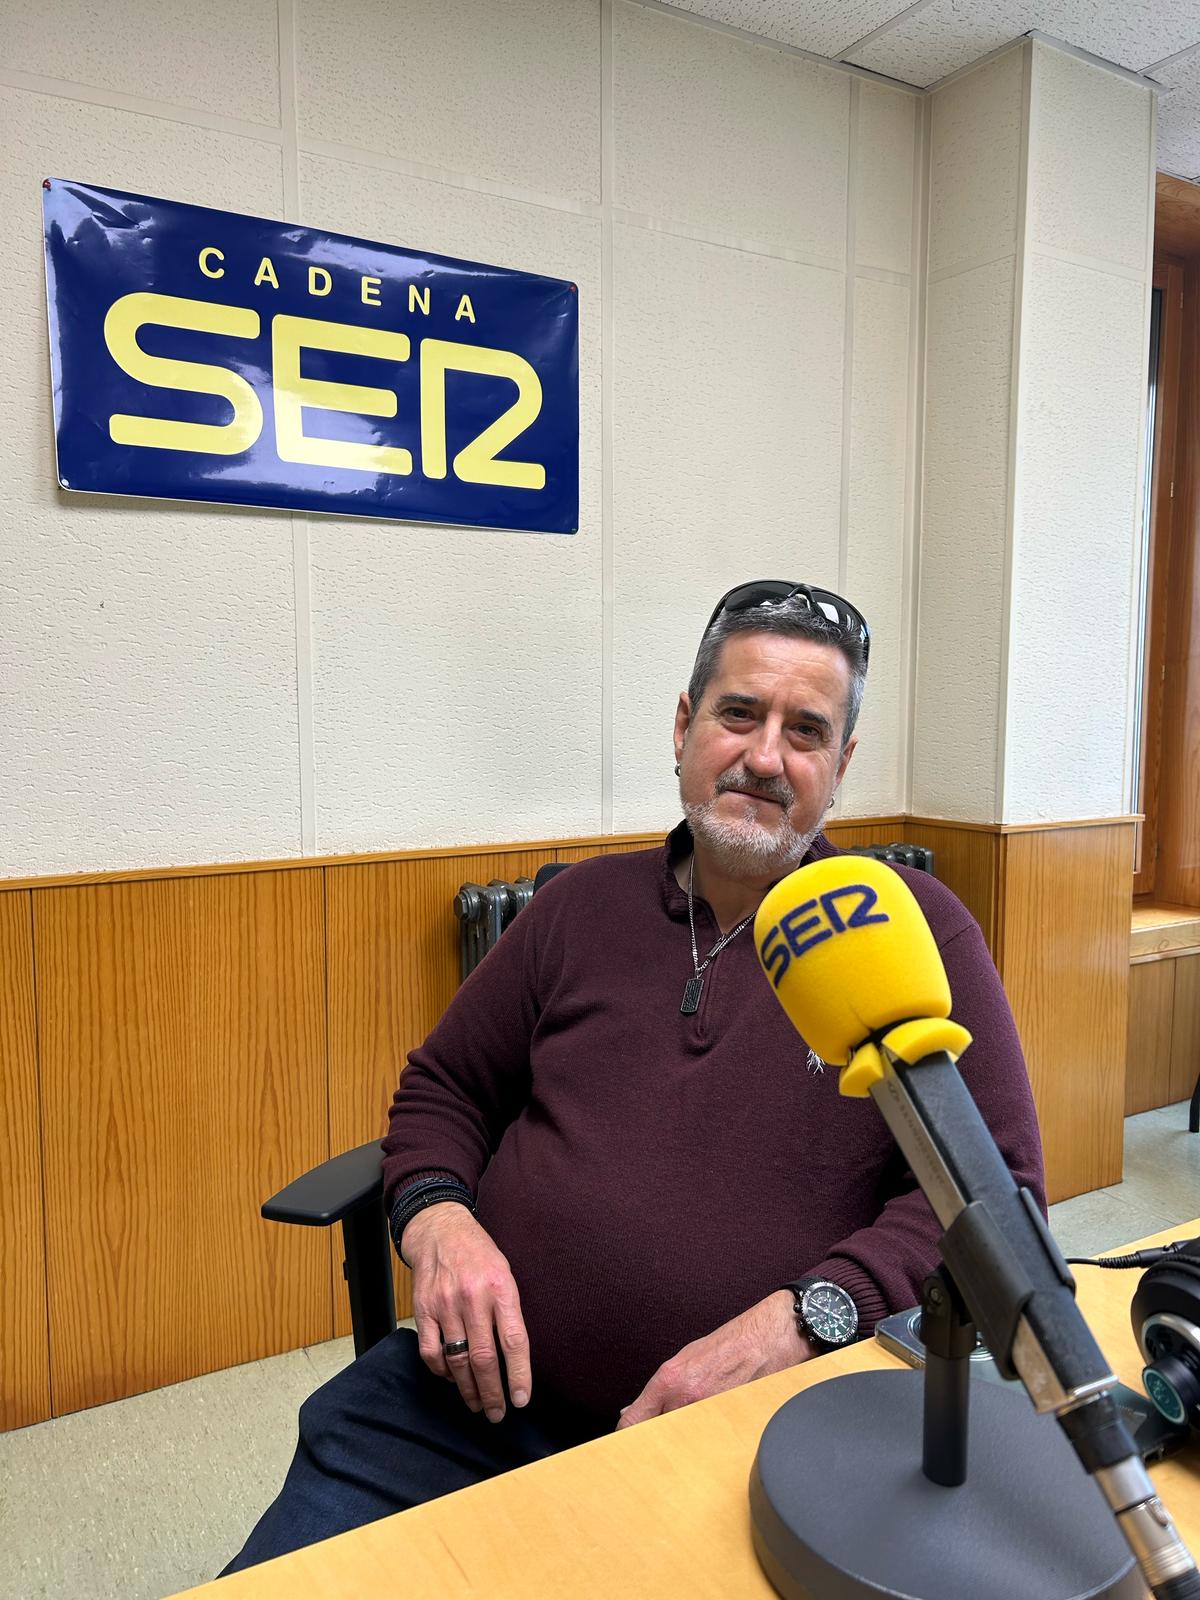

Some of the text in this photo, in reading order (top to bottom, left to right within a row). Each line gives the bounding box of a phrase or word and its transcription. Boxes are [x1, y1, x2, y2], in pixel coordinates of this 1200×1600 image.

[199, 247, 476, 323] CADENA
[104, 292, 546, 490] SER
[762, 885, 889, 988] SER
